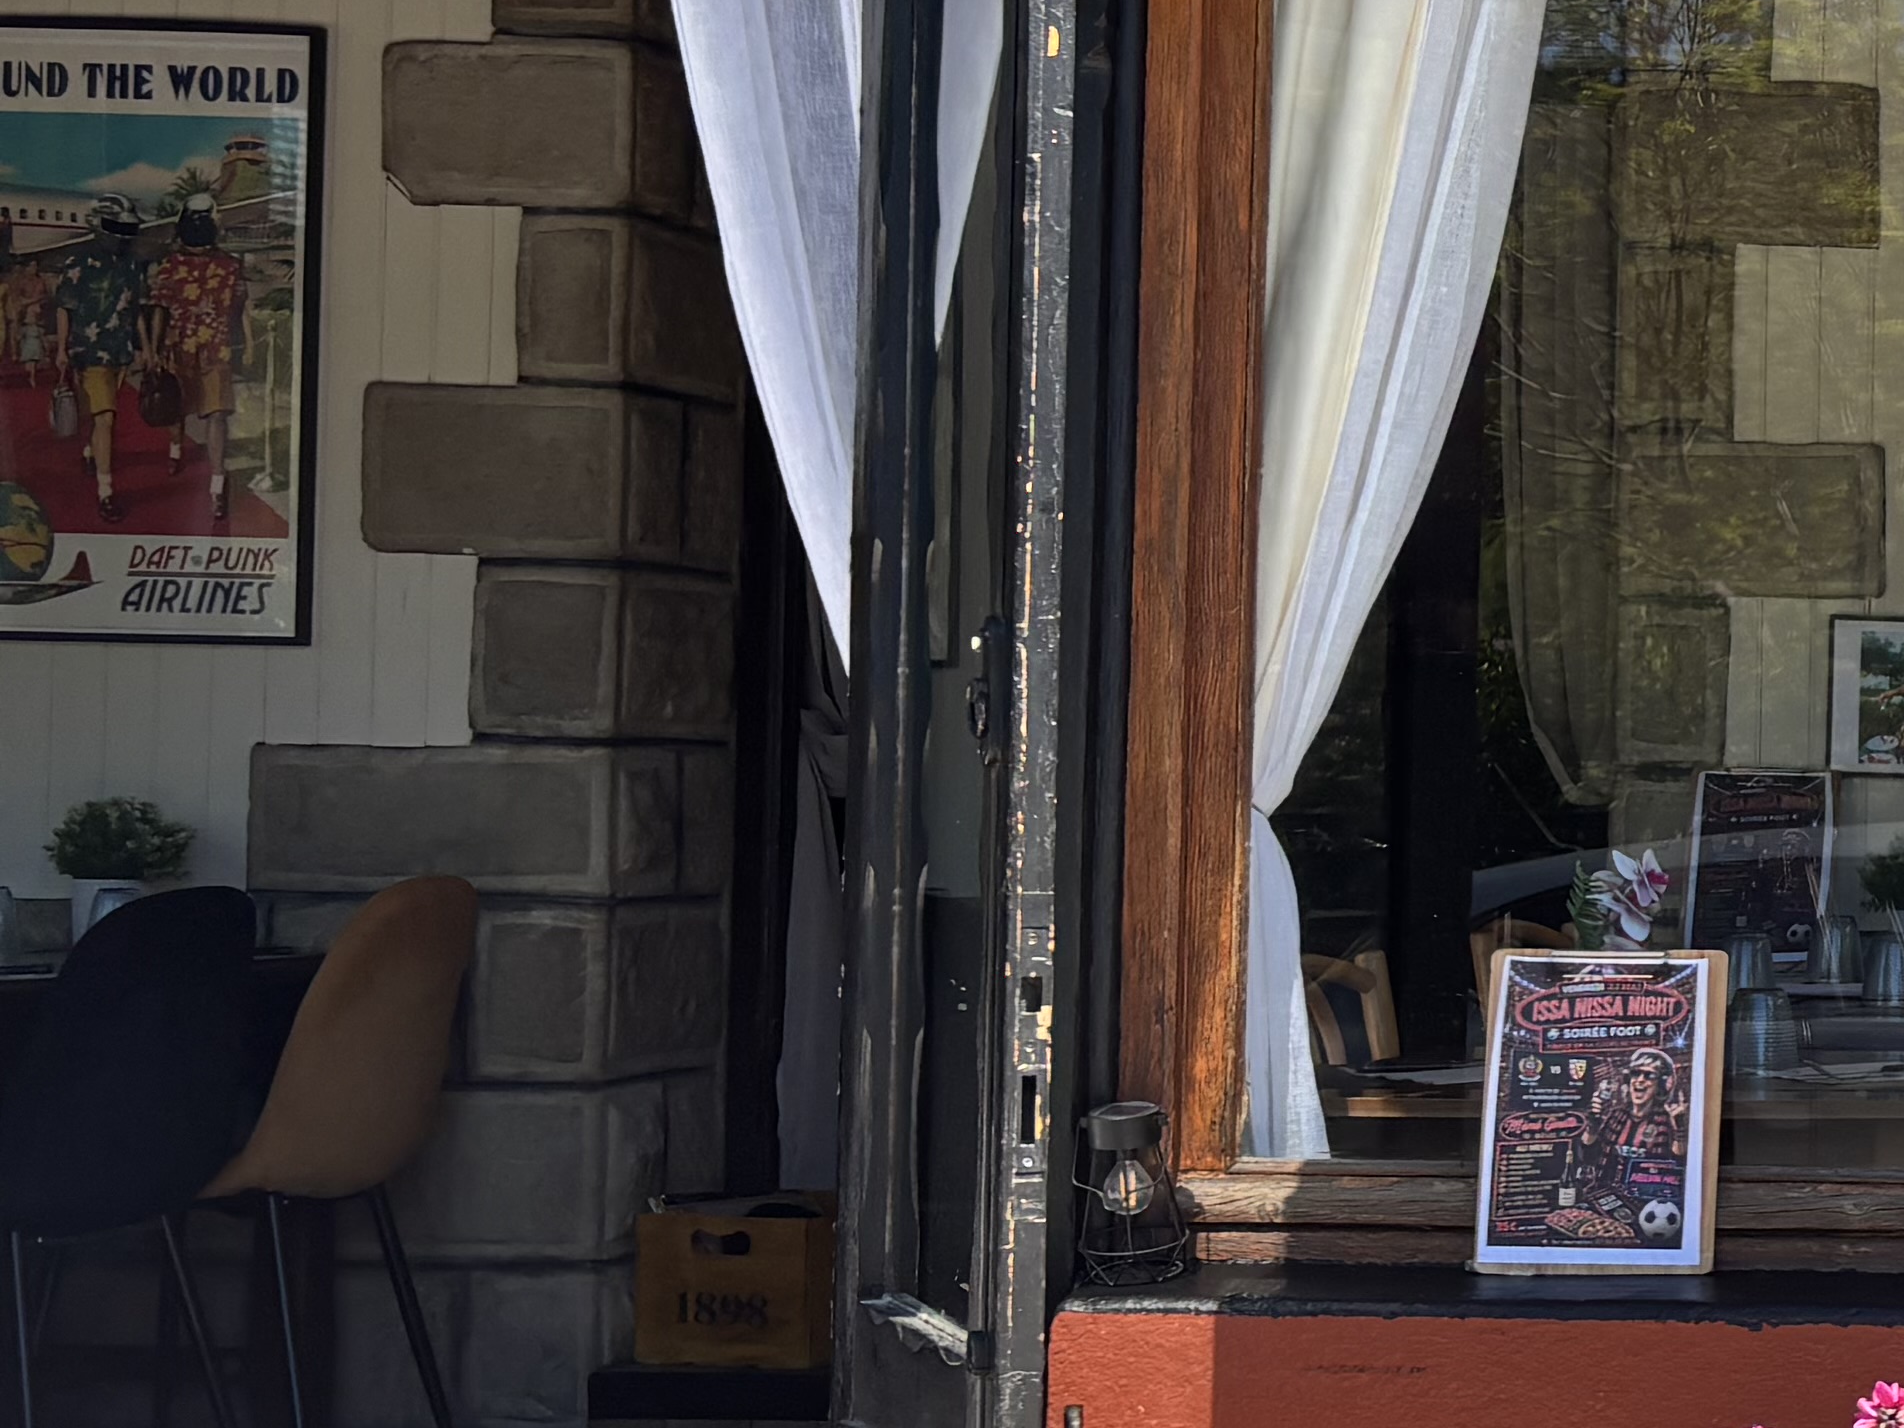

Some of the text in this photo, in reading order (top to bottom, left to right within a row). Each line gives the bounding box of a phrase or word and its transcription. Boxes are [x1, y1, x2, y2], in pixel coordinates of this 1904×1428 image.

[81, 62, 154, 100] THE
[166, 63, 300, 105] WORLD
[120, 578, 273, 615] AIRLINES
[1532, 994, 1679, 1022] ISSA NISSA NIGHT
[1609, 1024, 1642, 1037] FOOT
